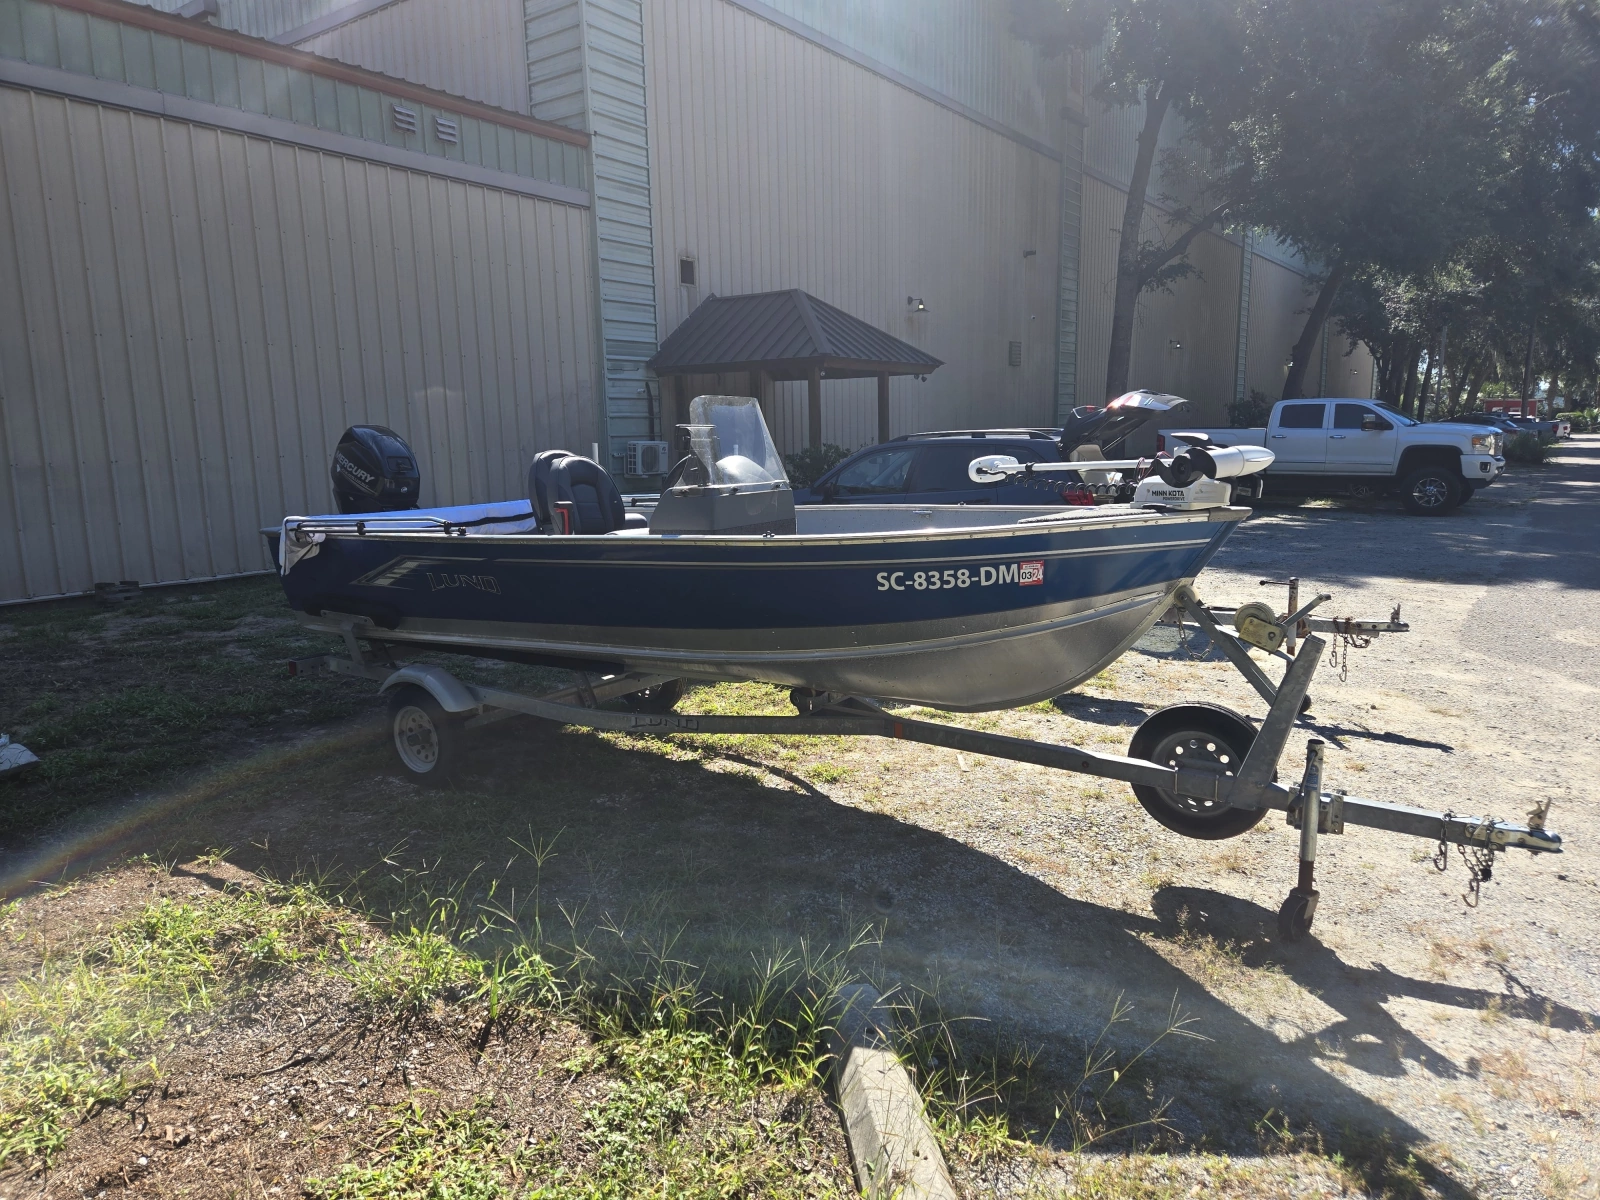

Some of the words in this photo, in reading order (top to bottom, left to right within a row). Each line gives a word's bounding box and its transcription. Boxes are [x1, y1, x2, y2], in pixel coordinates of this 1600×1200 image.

[336, 450, 375, 483] MERCURY
[426, 572, 502, 595] LUND
[876, 563, 1019, 591] SC-8358-DM
[631, 716, 699, 731] LUND
